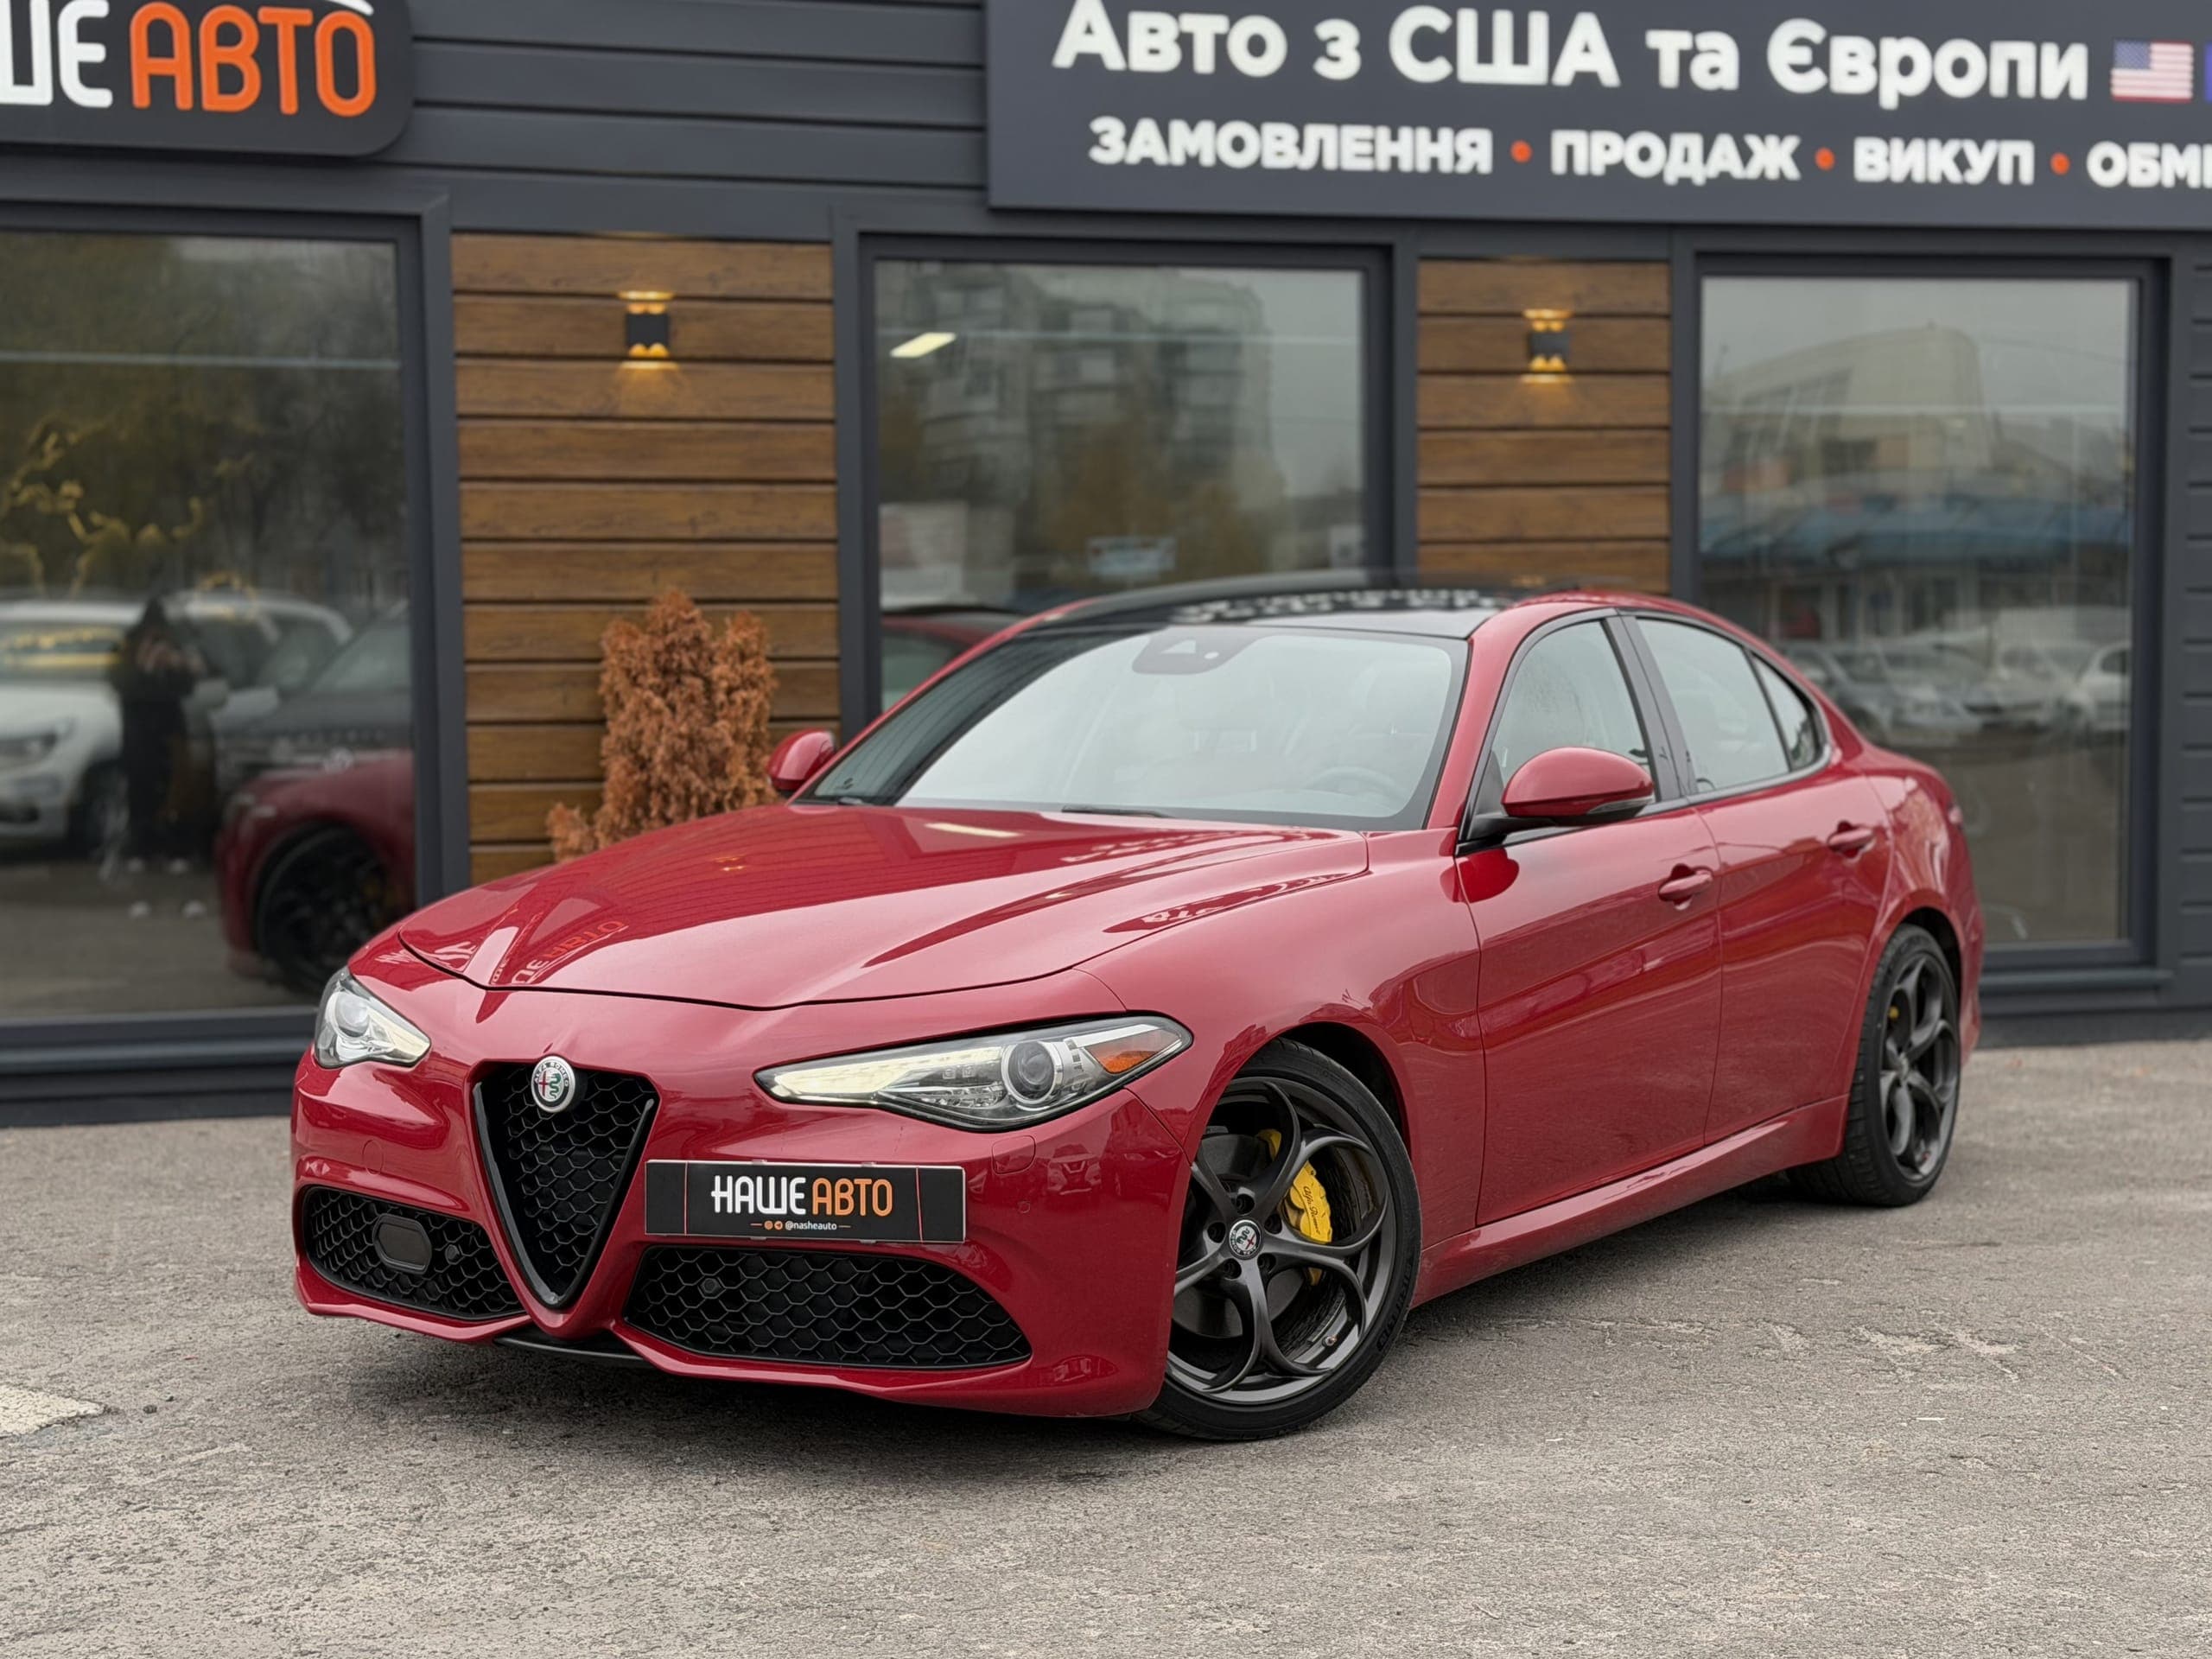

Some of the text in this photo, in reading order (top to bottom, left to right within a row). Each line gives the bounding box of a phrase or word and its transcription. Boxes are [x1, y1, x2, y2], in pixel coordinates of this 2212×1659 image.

[130, 1, 378, 118] АВТО
[1052, 0, 2088, 110] Авто з США та Європи
[1089, 116, 1493, 174] ЗАМОВЛЕННЯ
[1551, 130, 1801, 186] ПРОДАЖ
[1853, 137, 2035, 185] ВИКУП
[710, 1175, 893, 1217] НАШЕ АВТО
[785, 1220, 837, 1230] @nasheauto
